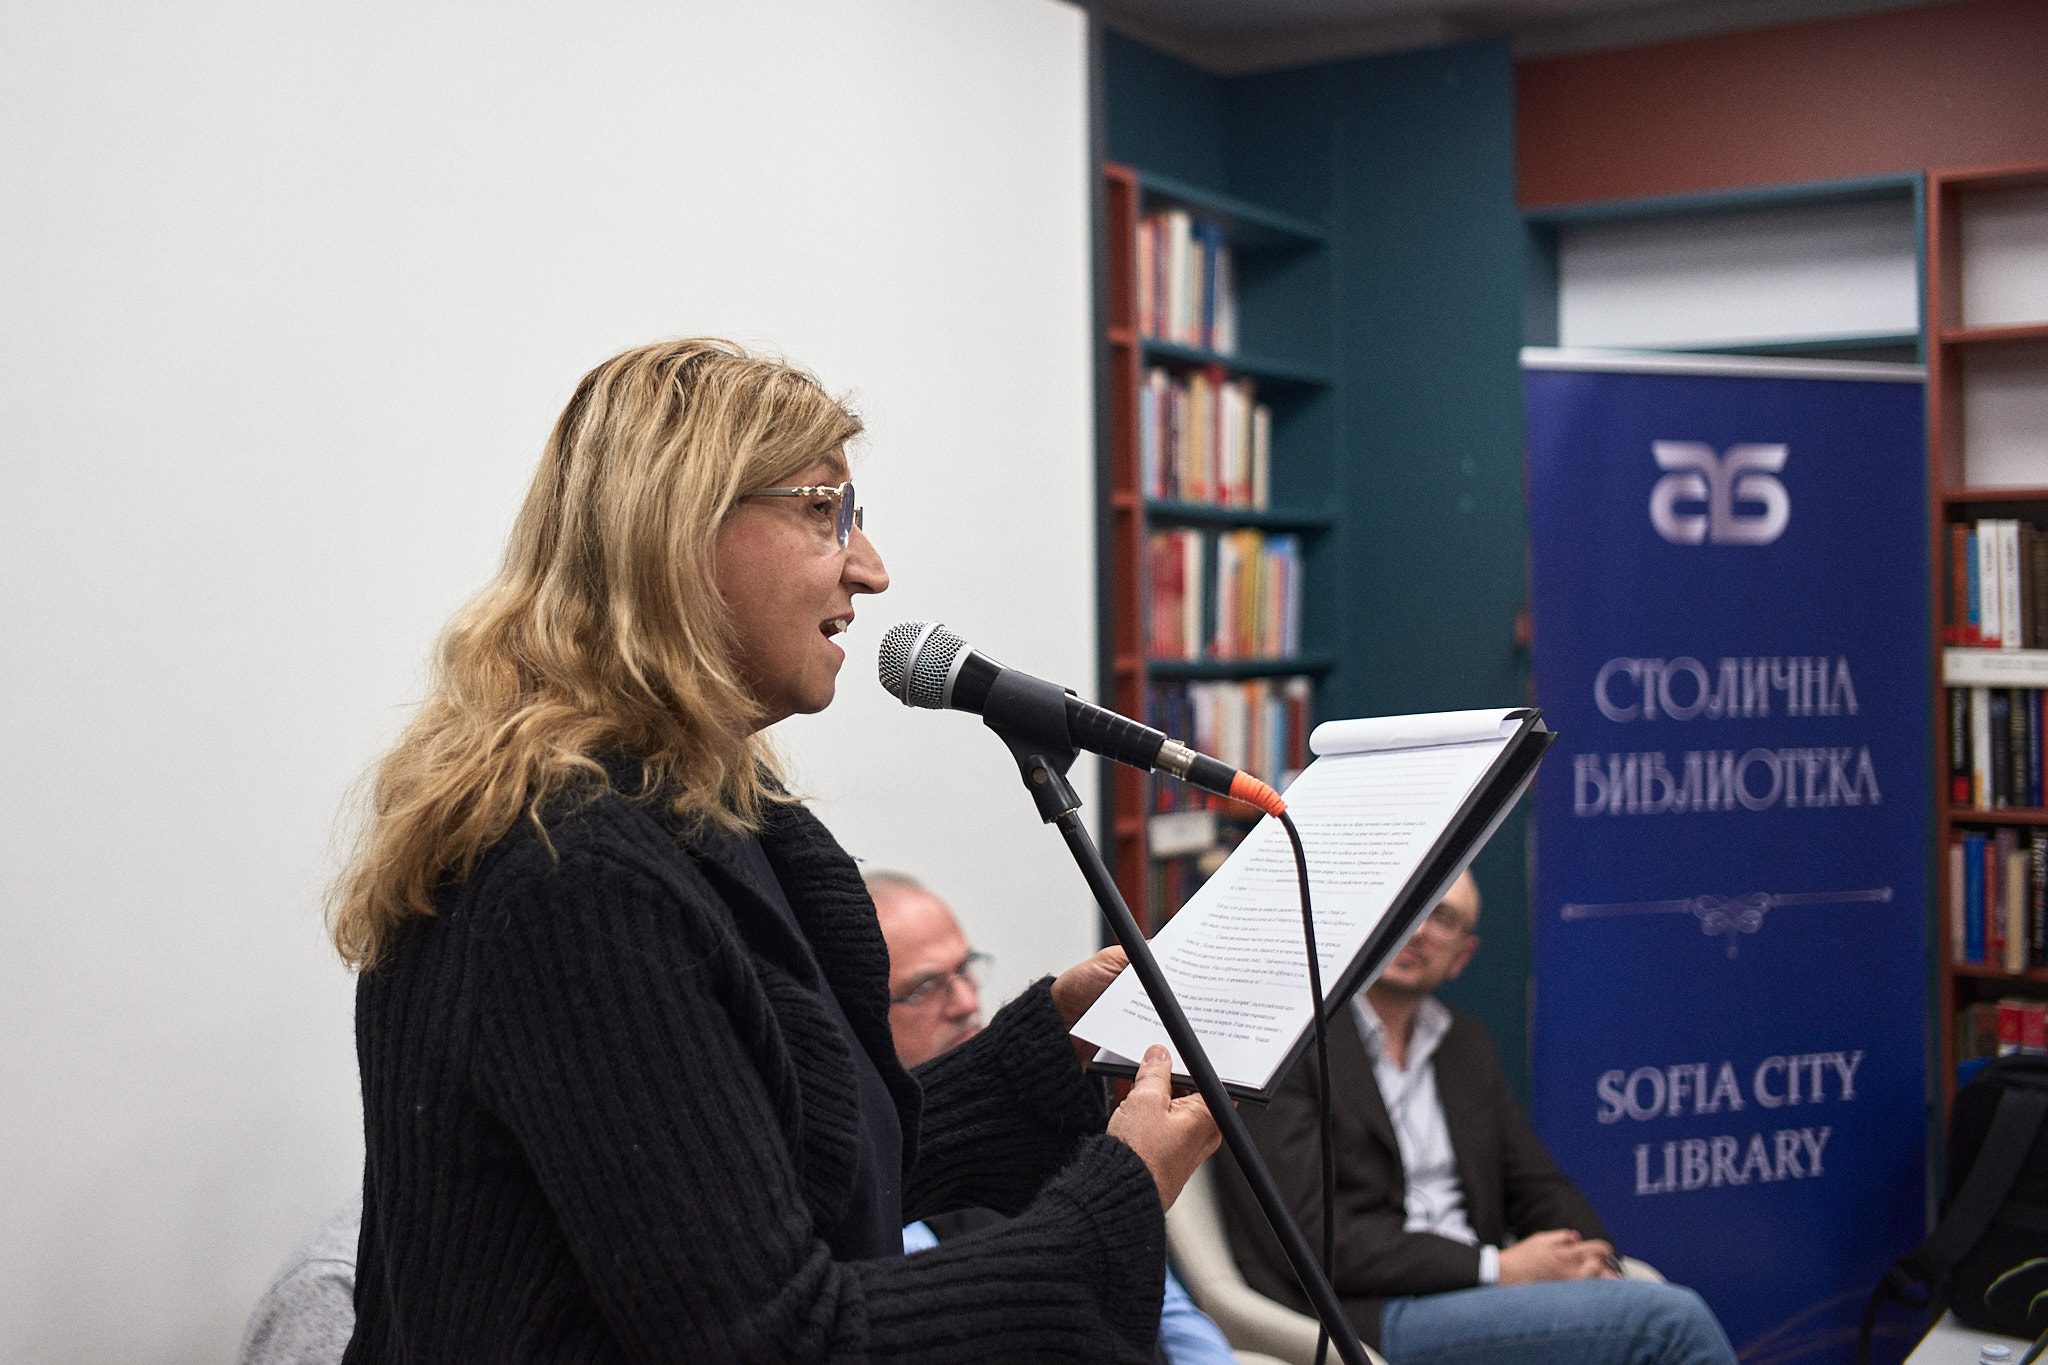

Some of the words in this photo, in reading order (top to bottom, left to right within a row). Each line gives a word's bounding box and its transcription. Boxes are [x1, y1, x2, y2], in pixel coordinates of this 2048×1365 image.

[1594, 656, 1859, 723] СТОЛИЧНА
[1574, 745, 1881, 817] БИБЛИОТЕКА
[1597, 1060, 1746, 1125] SOFIA
[1754, 1051, 1863, 1109] CITY
[1634, 1126, 1832, 1196] LIBRARY
